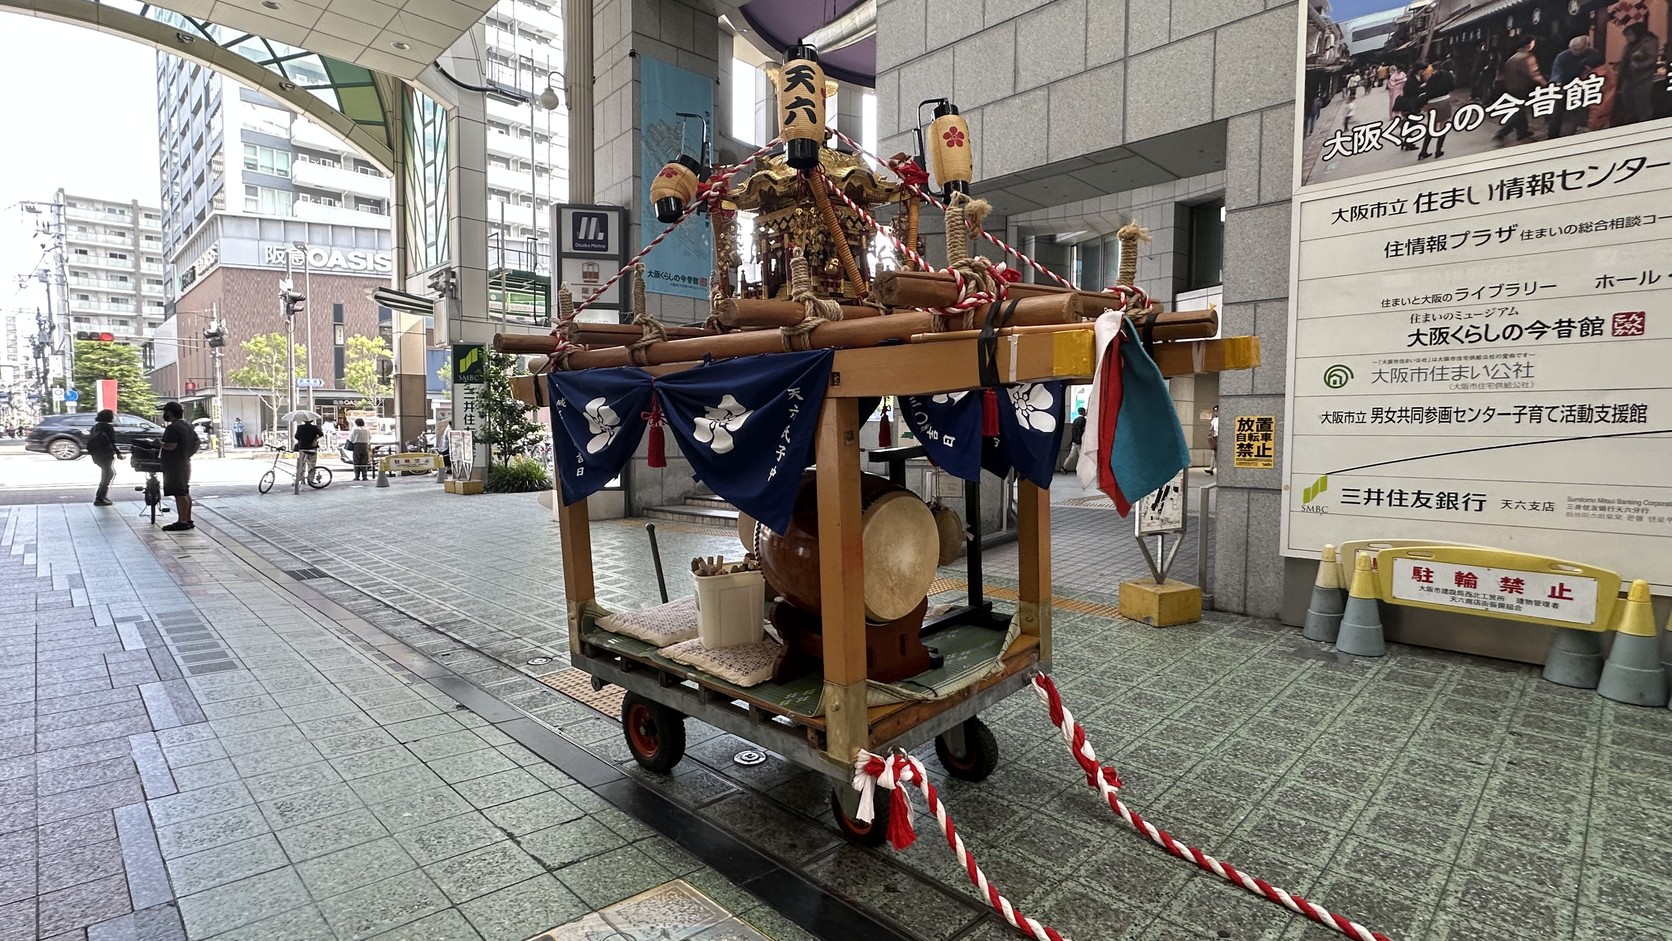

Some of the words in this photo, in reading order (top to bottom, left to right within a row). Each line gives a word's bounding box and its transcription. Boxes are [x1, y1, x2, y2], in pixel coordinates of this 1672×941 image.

[784, 64, 817, 126] 天六
[1322, 74, 1605, 161] 大阪くらしの今昔館
[1331, 199, 1408, 224] 大阪市立
[1413, 156, 1670, 214] 住まい情報センター
[1384, 223, 1518, 258] 住情報プラザ
[647, 269, 699, 285] 大阪くらしの今昔館
[1410, 306, 1519, 324] 住まいのミュージアム
[1407, 316, 1605, 348] 大阪くらしの今昔館
[1371, 361, 1535, 385] 大阪市住まい公社
[1237, 417, 1273, 432] 放置
[1320, 410, 1367, 425] 大阪市立
[1236, 432, 1273, 442] 自転車
[1237, 442, 1272, 457] 禁止
[1300, 505, 1330, 516] SMBC
[1341, 487, 1488, 513] 三井住友銀行
[1500, 499, 1556, 512] 天六支店
[1616, 499, 1642, 507] Banking
[1411, 565, 1574, 601] 駐輪禁止
